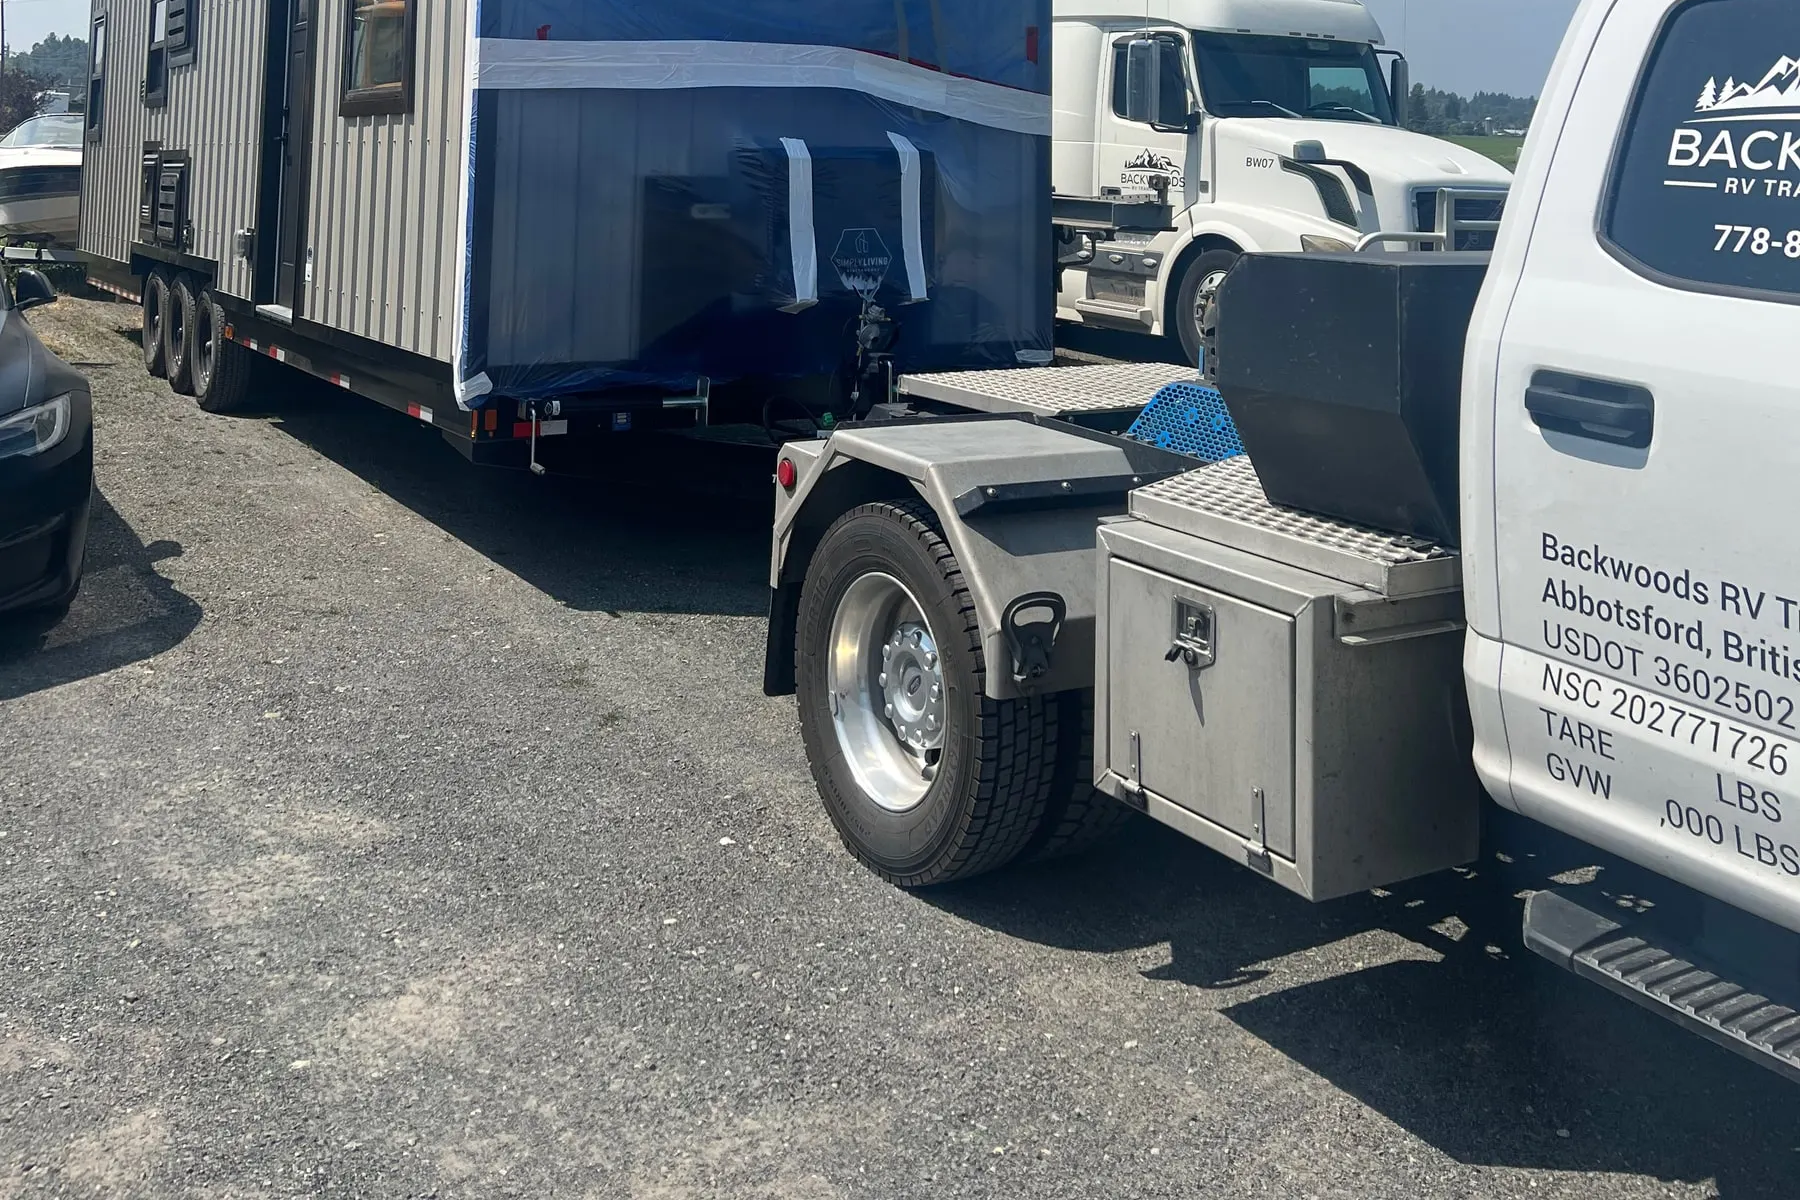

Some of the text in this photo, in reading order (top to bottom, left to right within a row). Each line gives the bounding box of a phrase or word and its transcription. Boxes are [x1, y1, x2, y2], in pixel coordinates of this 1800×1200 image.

[1120, 173, 1186, 188] BACKDS
[1246, 157, 1275, 169] BW07
[1668, 128, 1800, 171] BACK
[1724, 177, 1756, 195] RV
[1713, 224, 1800, 259] 778-8
[1541, 532, 1800, 633] Backwoods RV T
[1542, 578, 1712, 659] Abbotsford,
[1543, 620, 1796, 731] USDOT 3602502
[1542, 664, 1788, 776] NSC 202771726
[1539, 707, 1783, 824] TARE LBS
[1546, 752, 1611, 800] GVW
[1734, 824, 1800, 877] LBS
